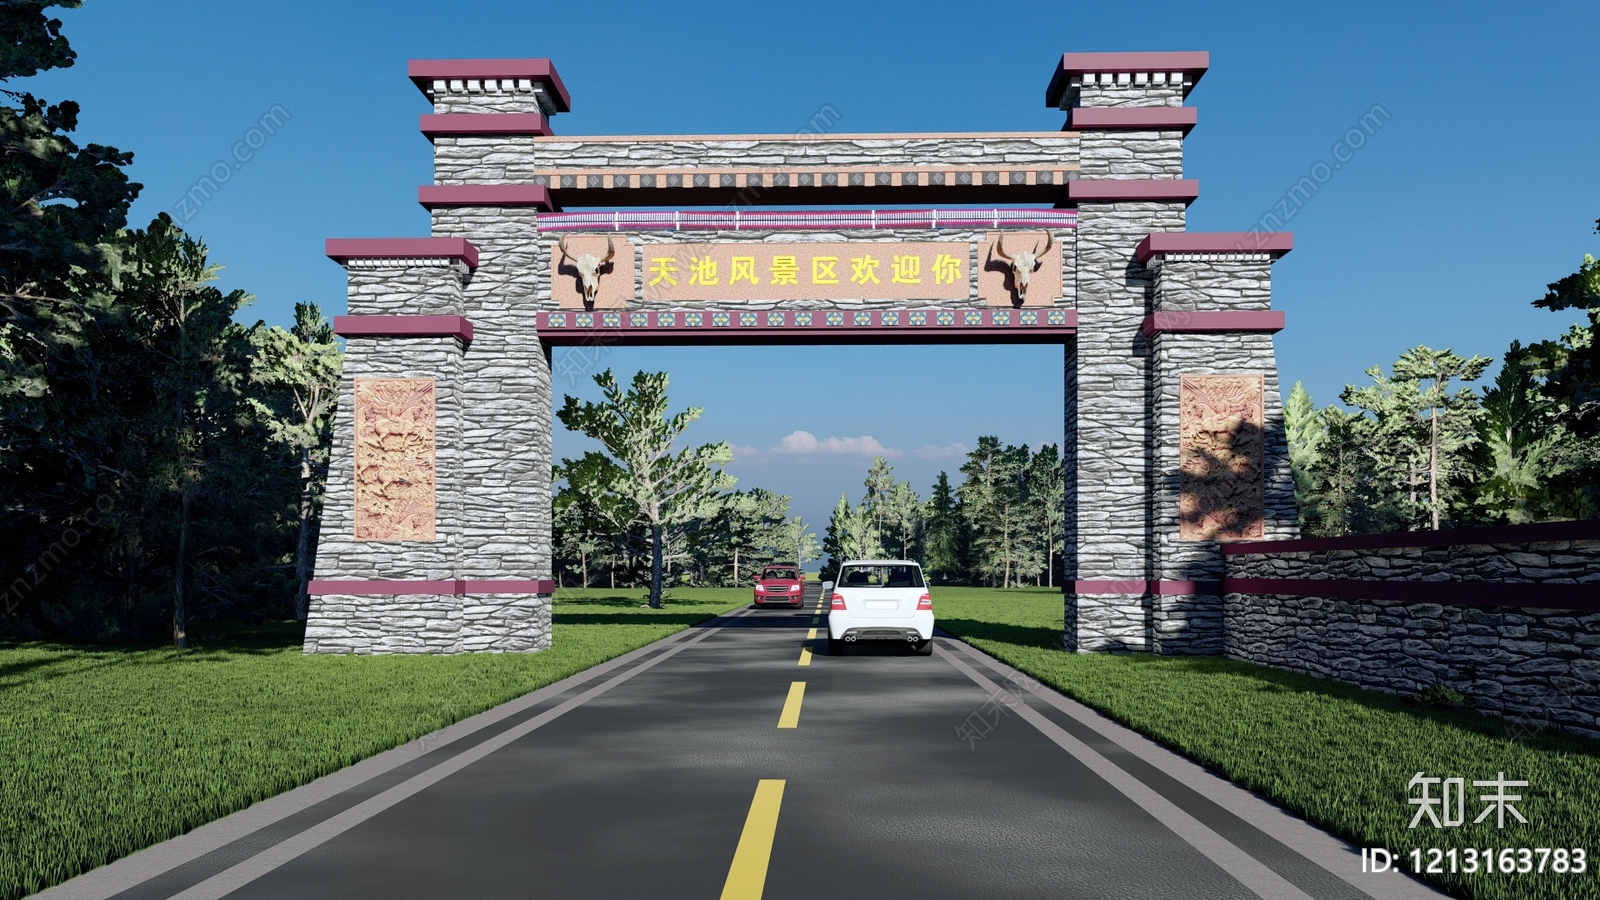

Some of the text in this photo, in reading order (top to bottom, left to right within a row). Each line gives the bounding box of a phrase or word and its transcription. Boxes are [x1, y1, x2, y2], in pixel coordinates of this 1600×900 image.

[649, 254, 962, 286] 天池风景区欢迎你
